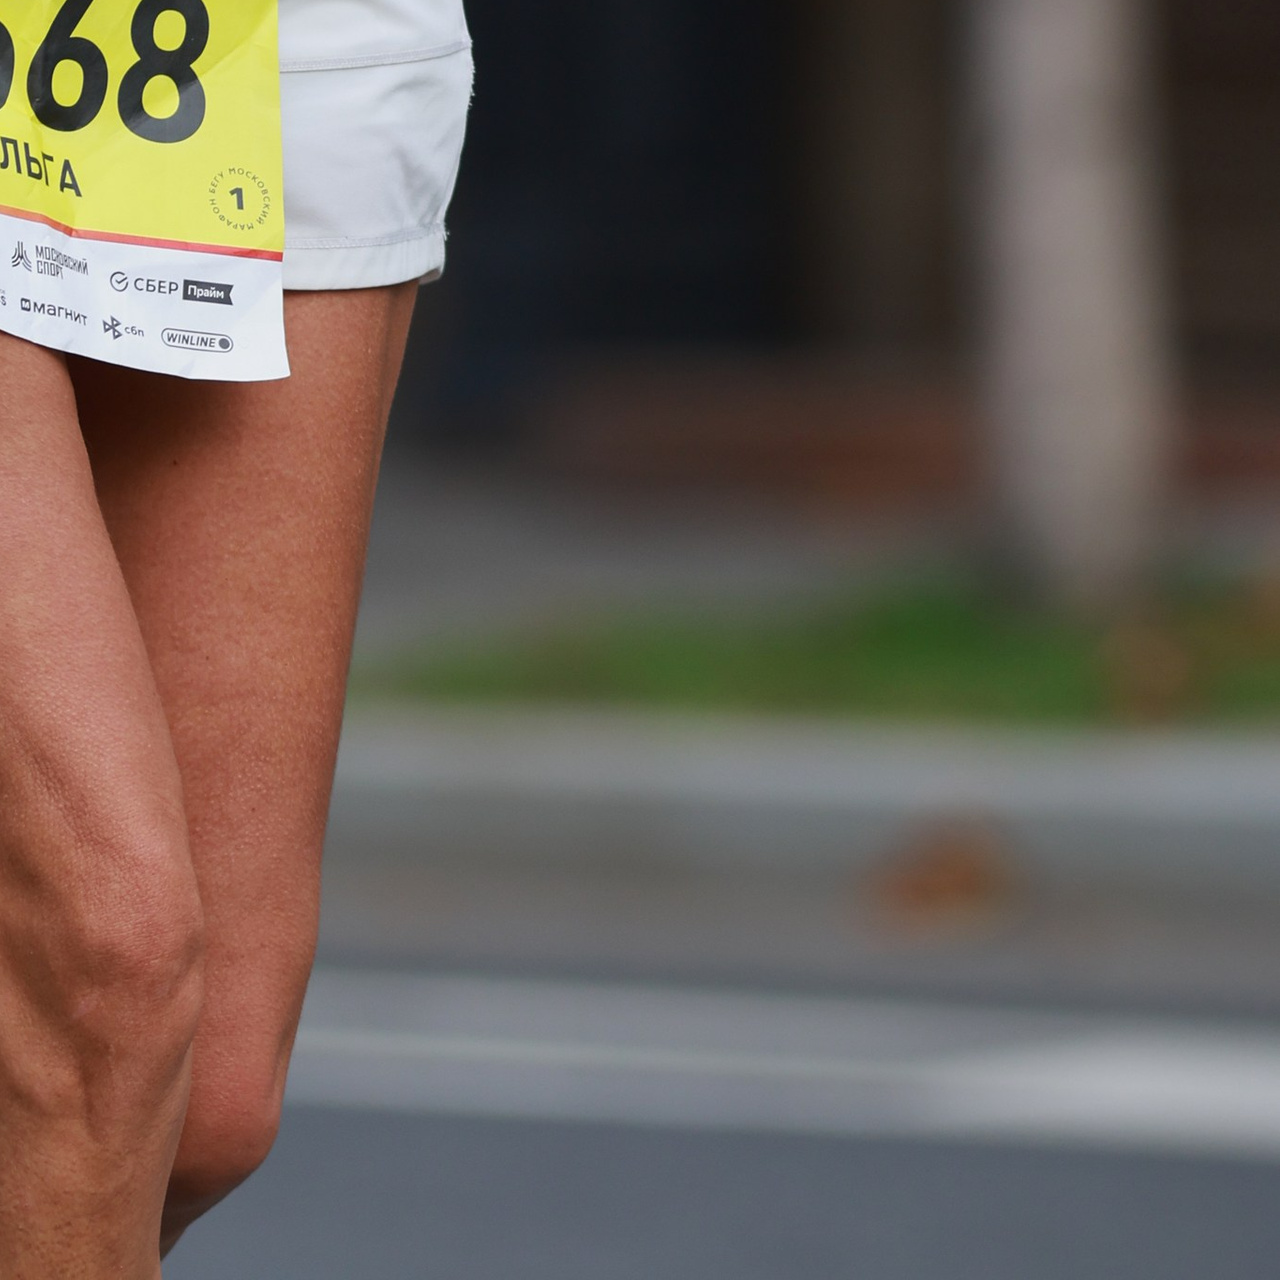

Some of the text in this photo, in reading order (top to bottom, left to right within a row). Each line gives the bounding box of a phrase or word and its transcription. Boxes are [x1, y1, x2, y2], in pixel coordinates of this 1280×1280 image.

[229, 186, 244, 211] 1
[35, 244, 89, 276] МОСКОВСКИЙ
[36, 259, 64, 280] СПОРТ
[133, 277, 225, 299] СБЕР Прайм
[124, 325, 145, 338] сбп
[166, 331, 217, 349] WINLINE
